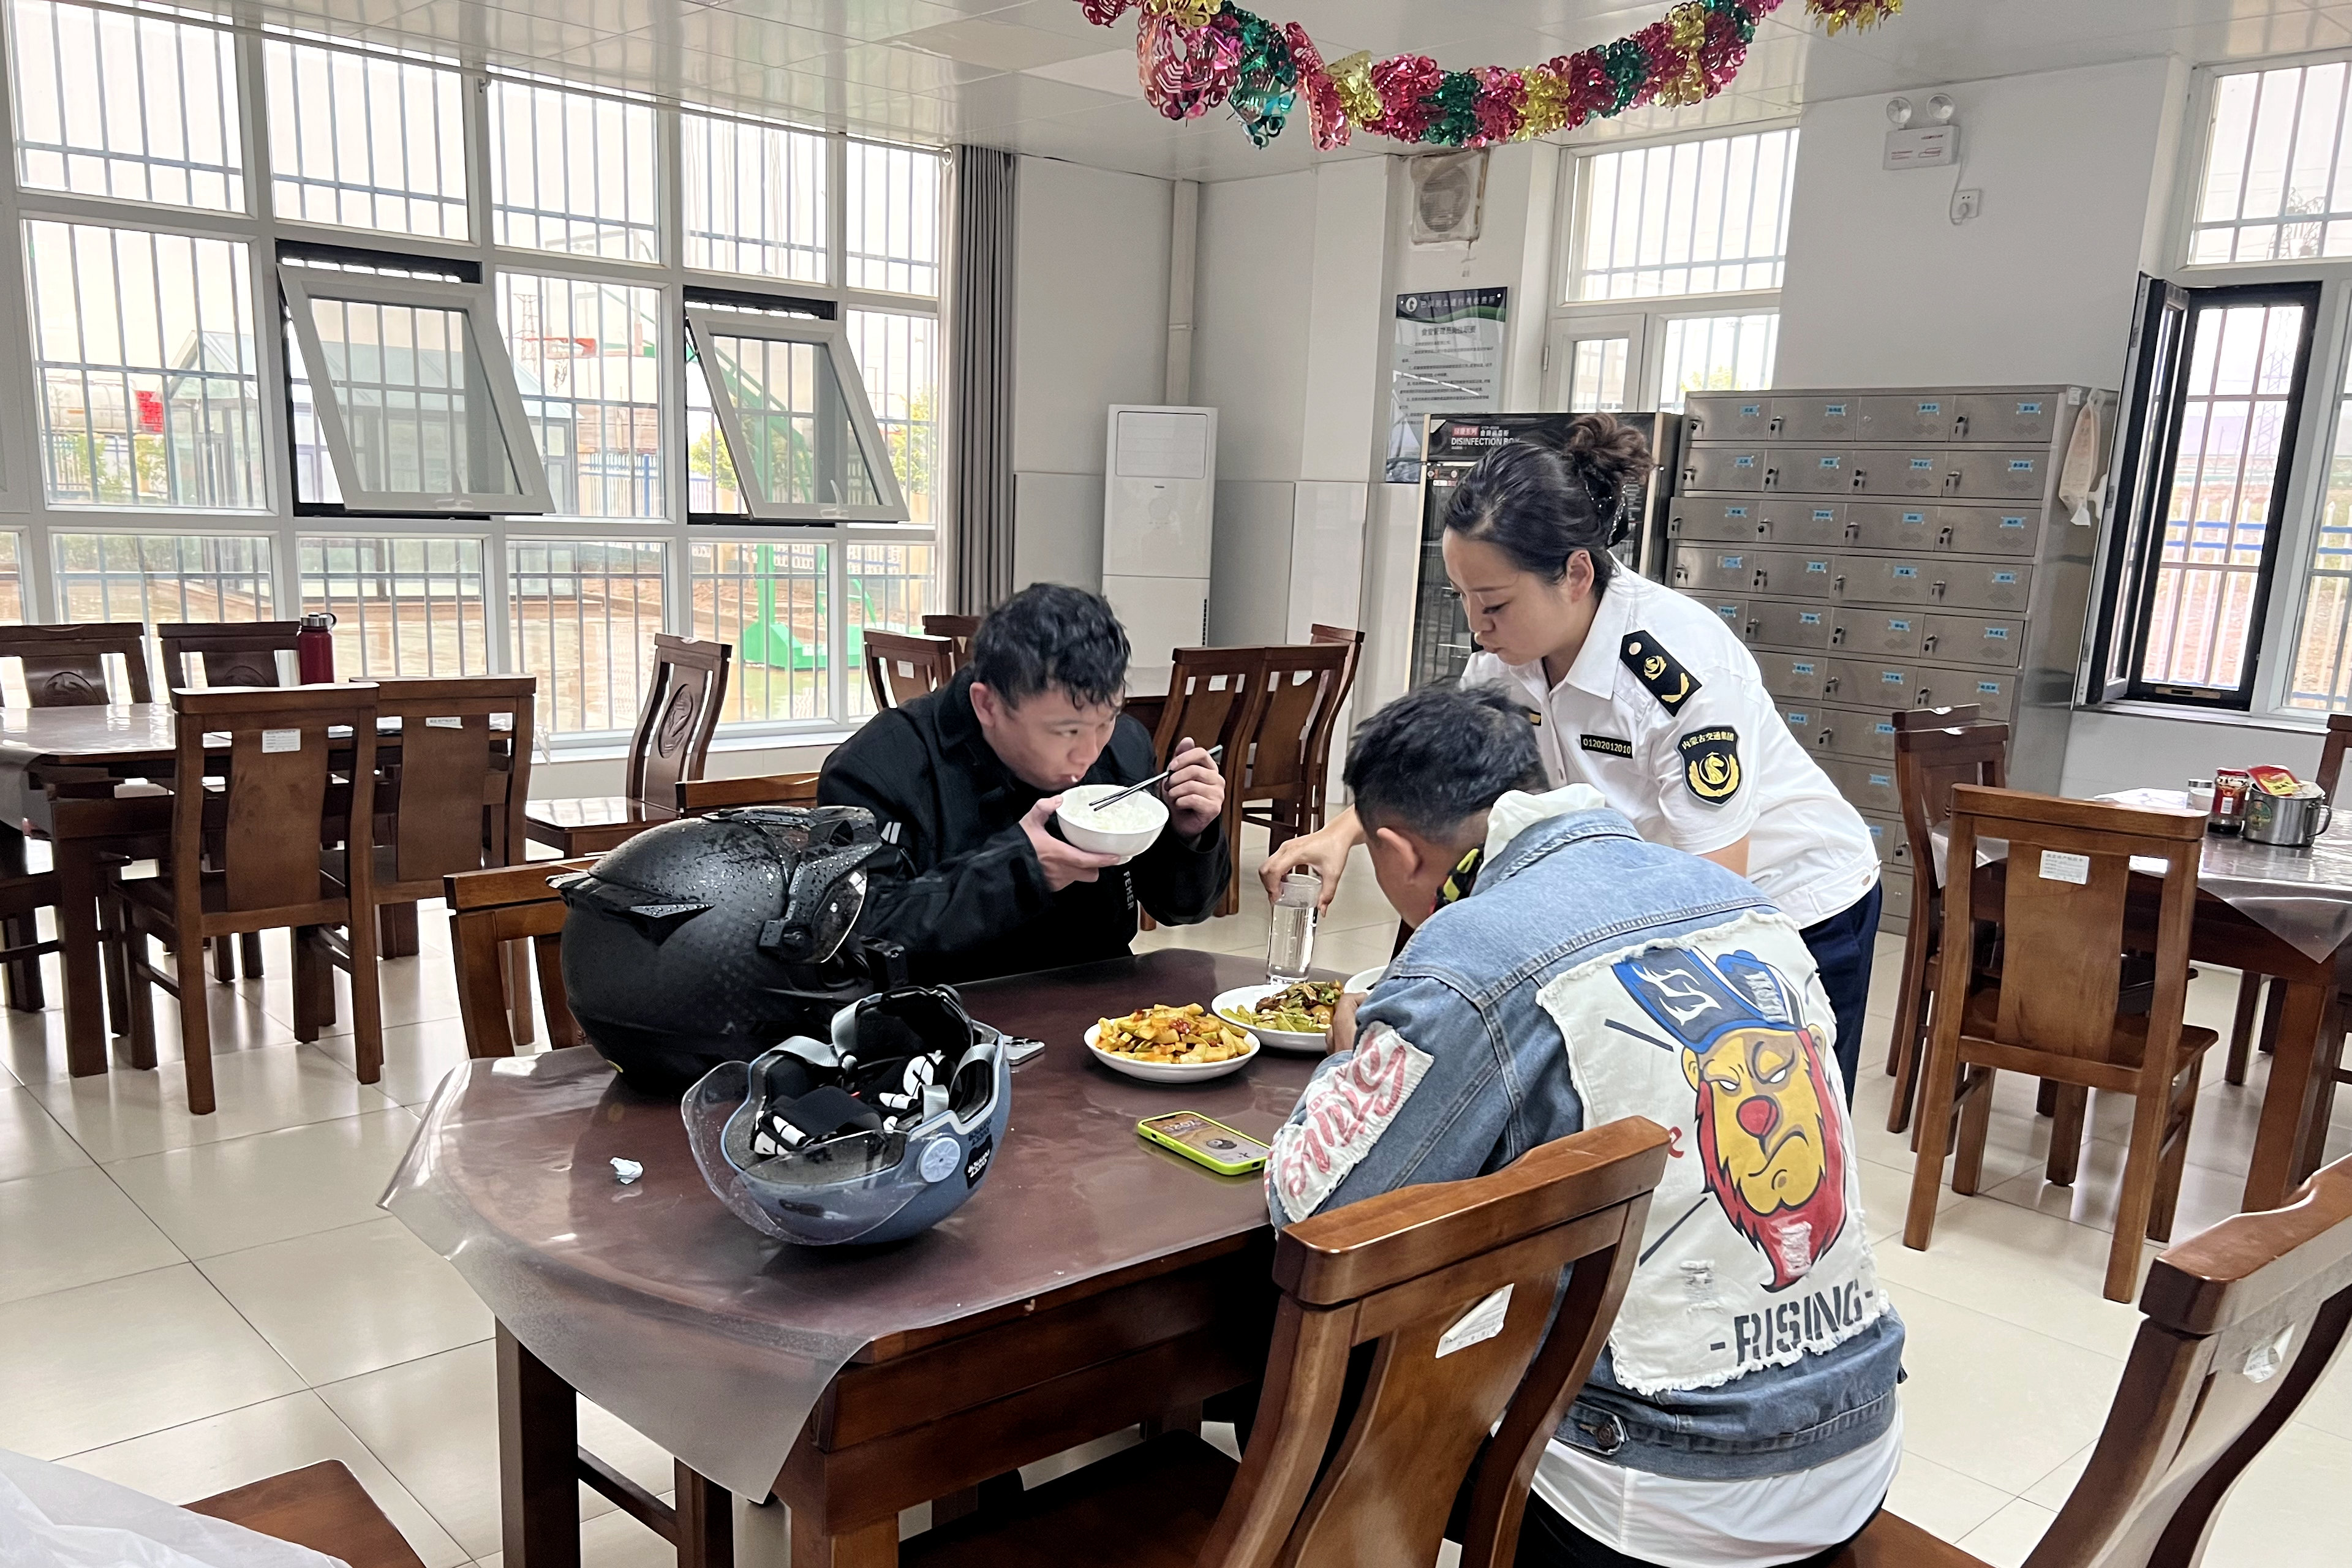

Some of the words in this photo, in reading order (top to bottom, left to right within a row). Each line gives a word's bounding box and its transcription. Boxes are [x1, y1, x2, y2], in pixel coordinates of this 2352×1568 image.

[1451, 437, 1502, 446] DISINFECTION
[1583, 738, 1632, 755] 01202012010
[1681, 731, 1735, 750] 内蒙古交通集团
